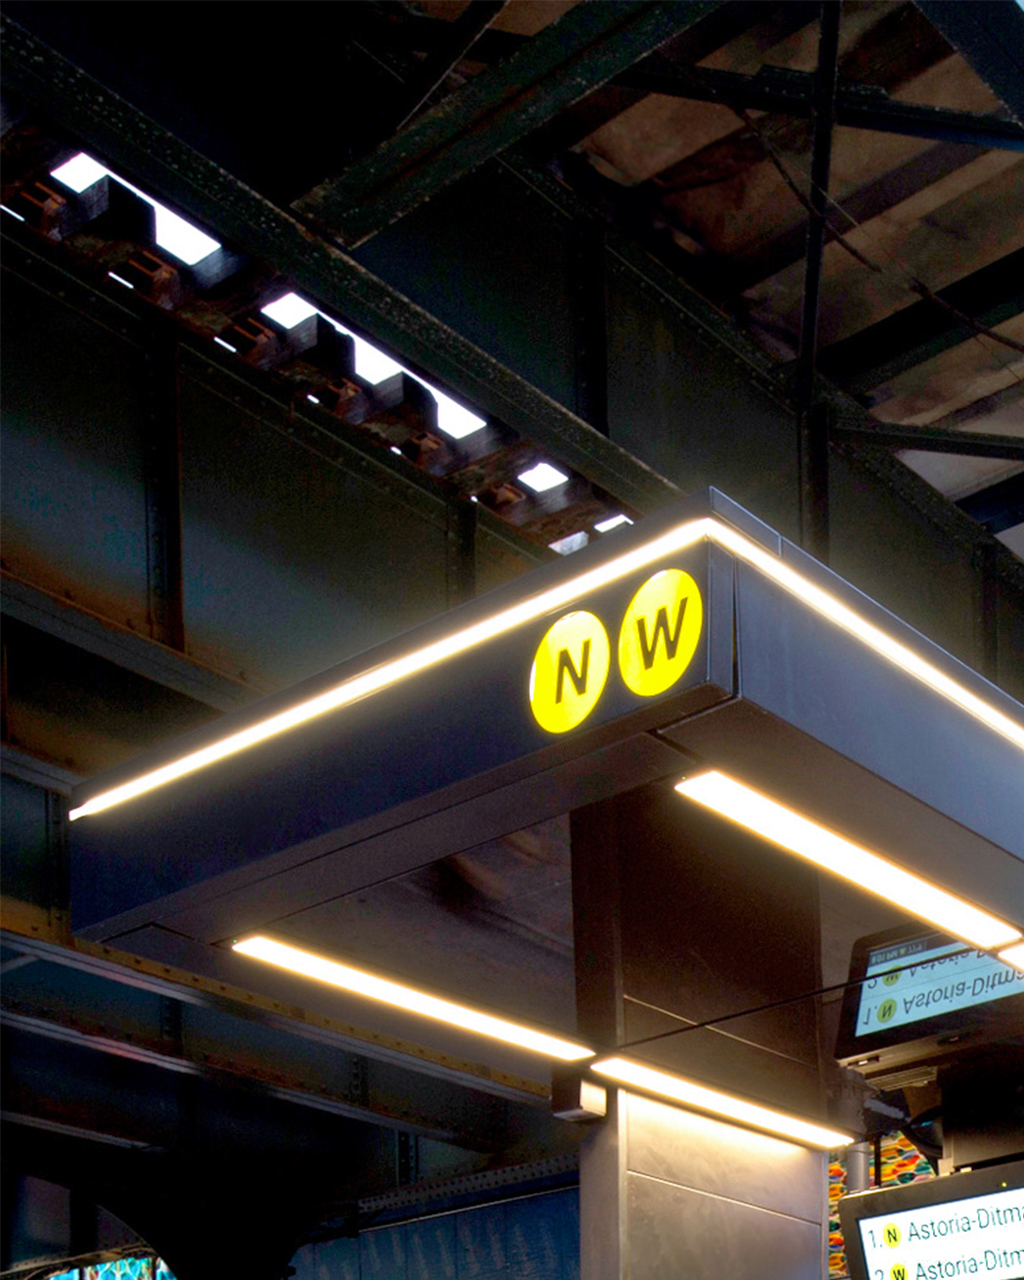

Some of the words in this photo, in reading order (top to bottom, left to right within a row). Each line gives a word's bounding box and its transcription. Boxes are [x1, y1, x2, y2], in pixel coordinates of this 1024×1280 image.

[556, 639, 591, 704] N
[635, 597, 688, 671] W
[887, 1228, 897, 1244] N
